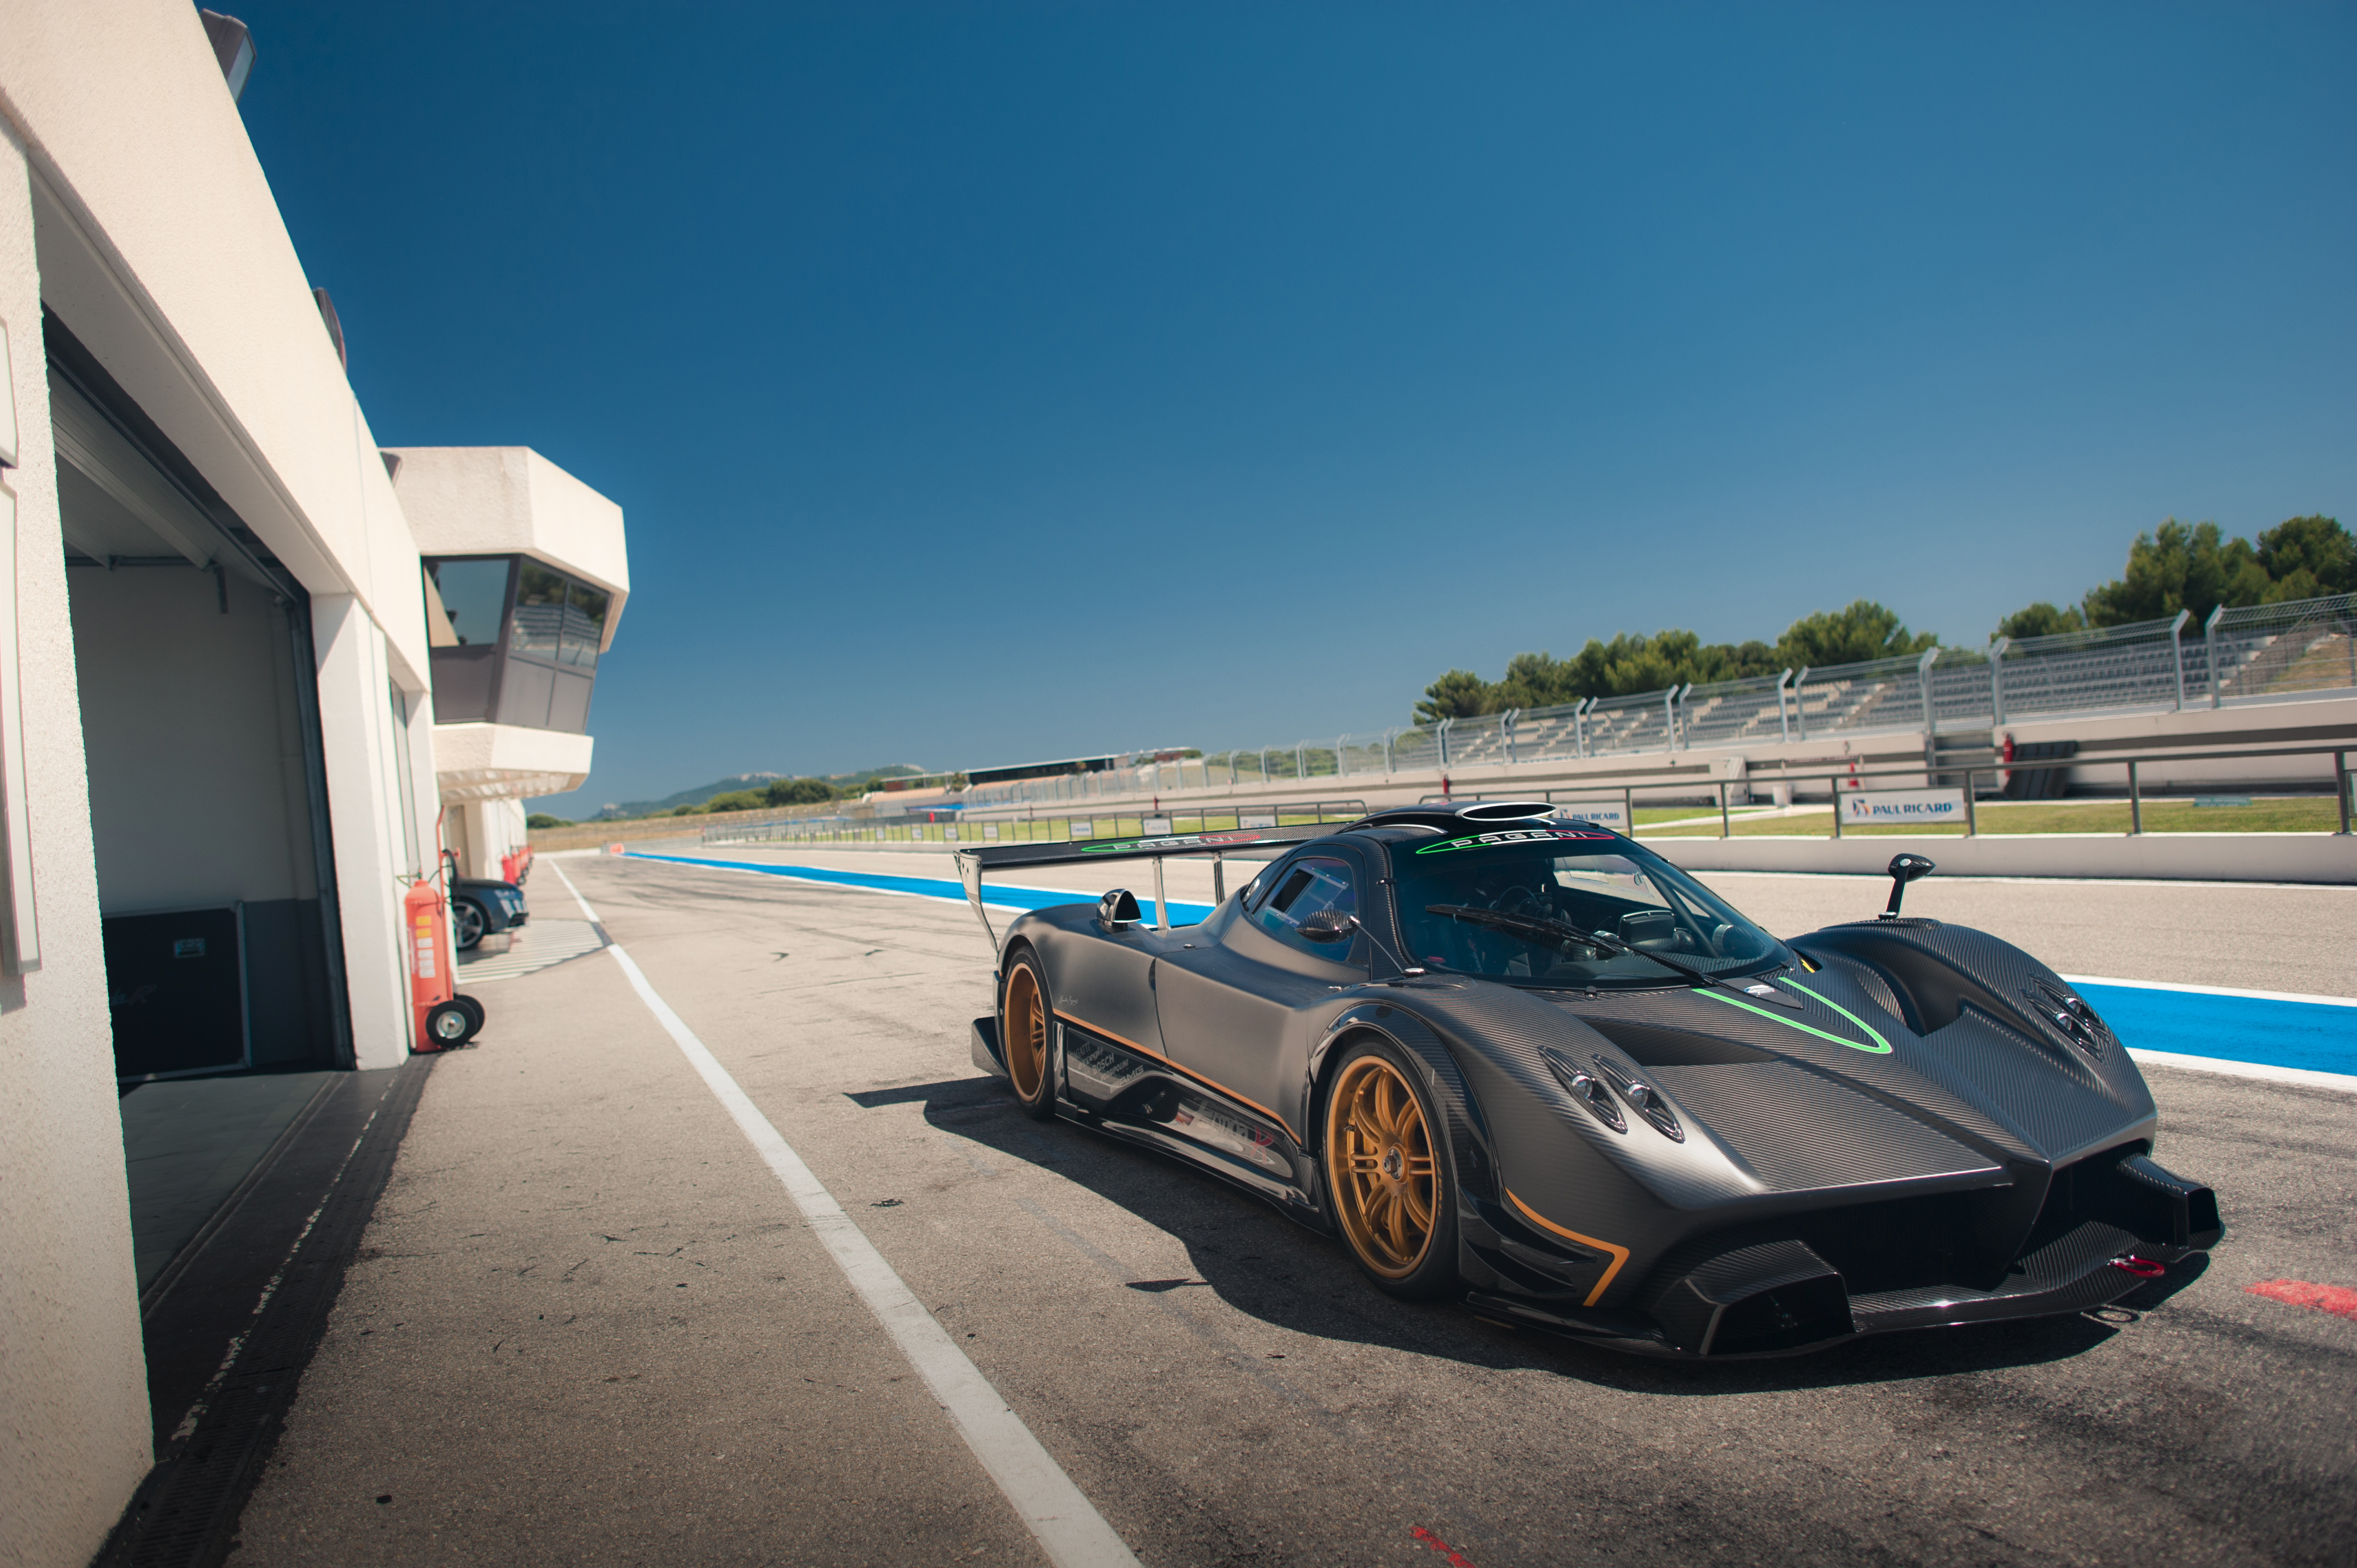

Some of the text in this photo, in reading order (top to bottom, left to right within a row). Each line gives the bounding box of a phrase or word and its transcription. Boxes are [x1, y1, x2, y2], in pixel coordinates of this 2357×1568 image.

[1591, 812, 1619, 821] RICARD
[1873, 802, 1952, 815] PAUL RICARD
[1113, 836, 1234, 850] PAGANI
[1450, 831, 1588, 848] PAGANI
[1092, 1053, 1114, 1075] BOSCH
[1119, 1065, 1144, 1086] AMG
[1250, 1125, 1274, 1165] R
